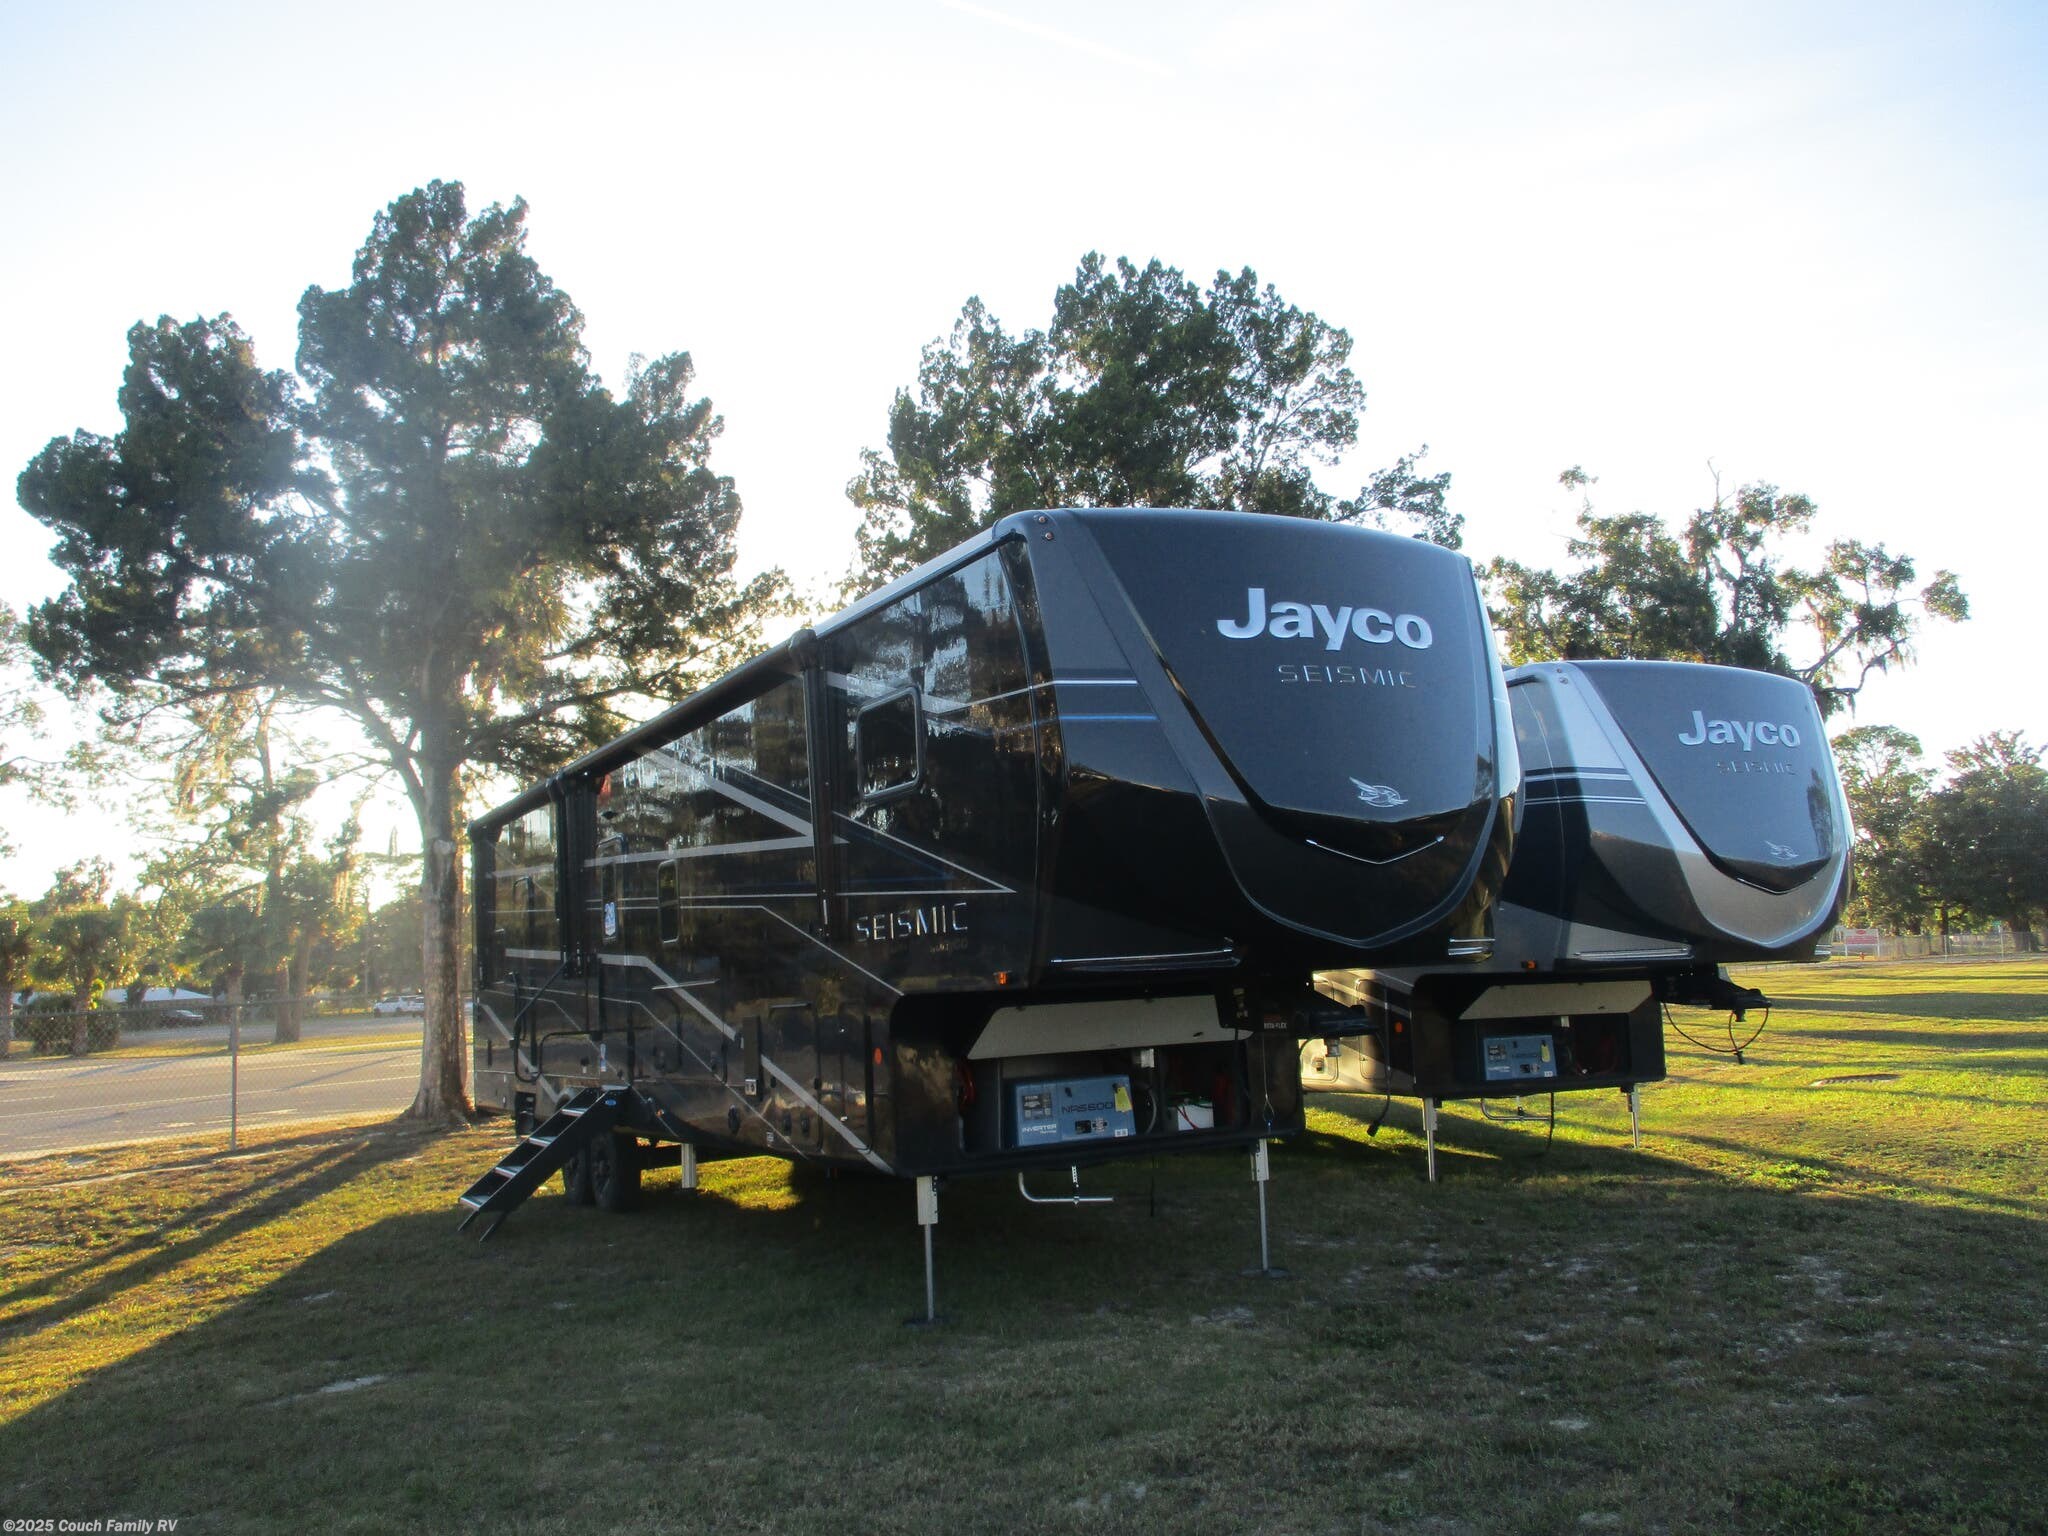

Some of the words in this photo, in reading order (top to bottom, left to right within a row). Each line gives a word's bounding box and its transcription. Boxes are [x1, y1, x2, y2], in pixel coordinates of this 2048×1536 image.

[1216, 587, 1433, 651] Jayco
[1277, 664, 1417, 689] SEISMIC
[1678, 710, 1801, 752] Jayco
[855, 902, 969, 942] SEISMIC
